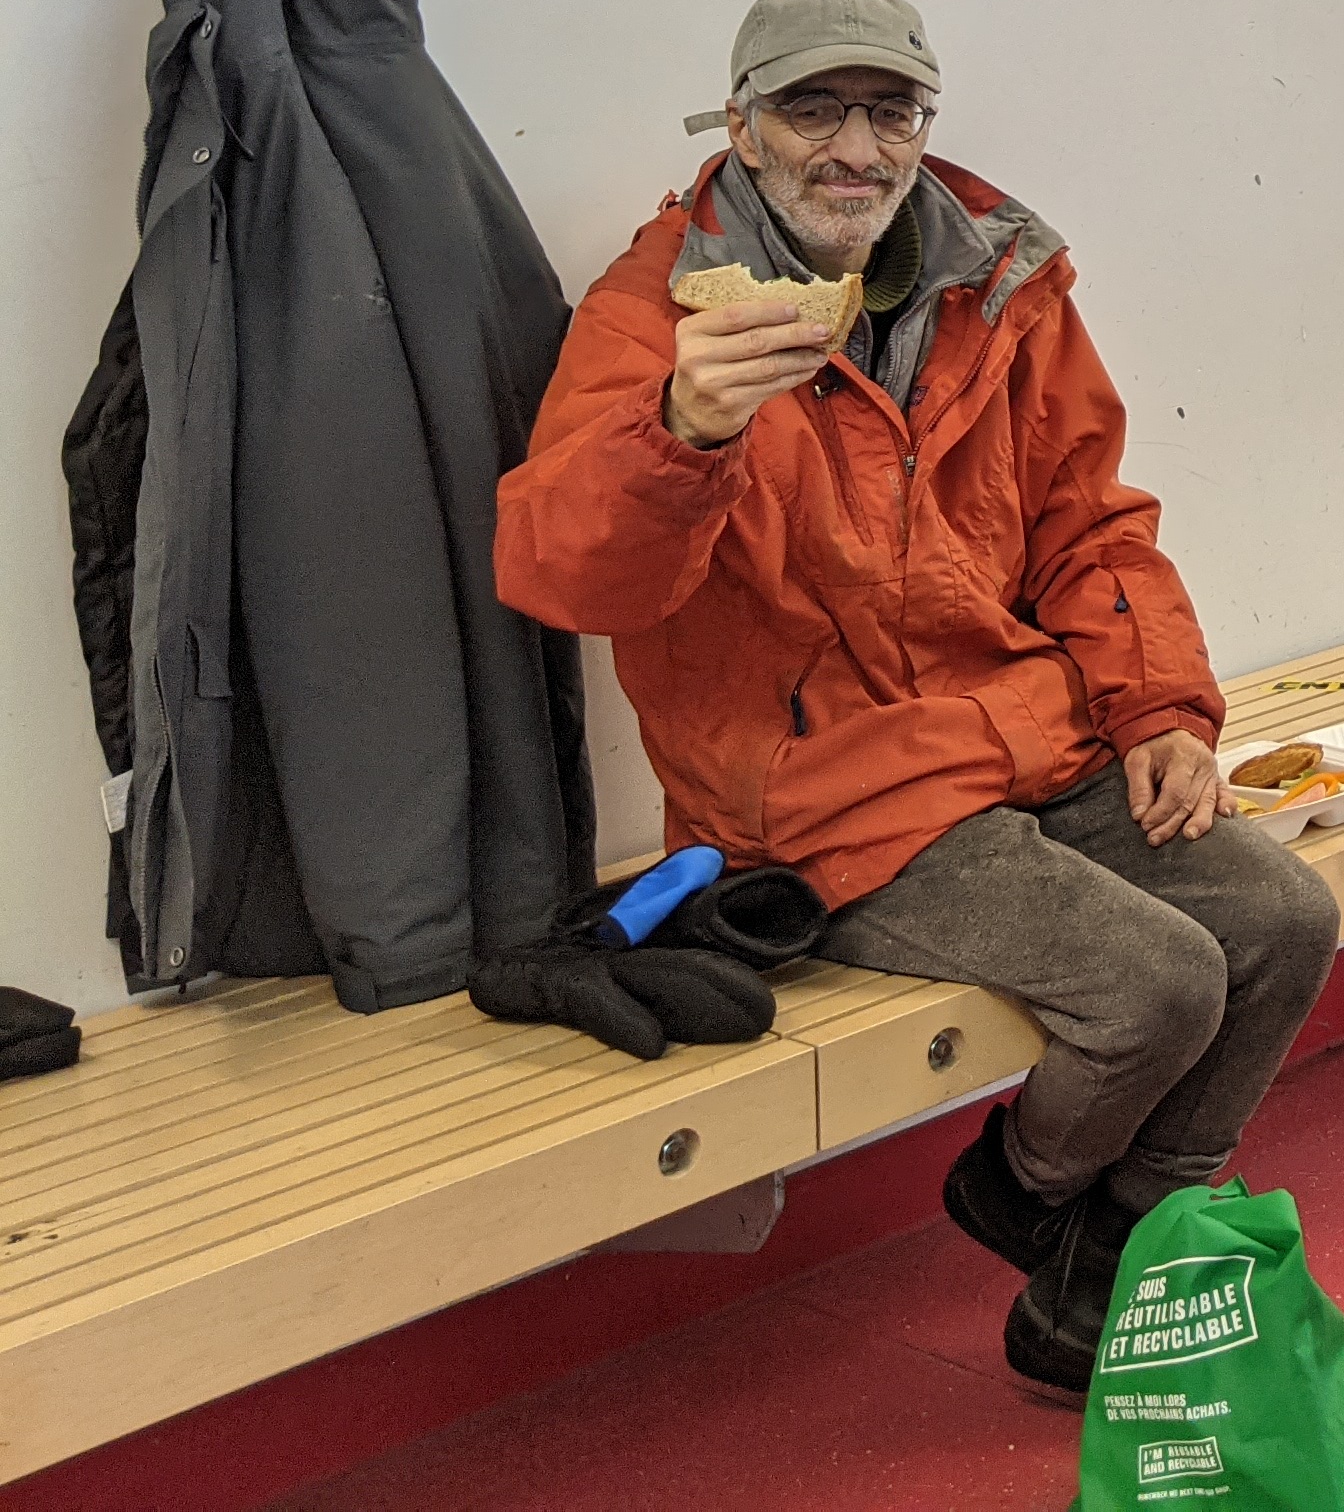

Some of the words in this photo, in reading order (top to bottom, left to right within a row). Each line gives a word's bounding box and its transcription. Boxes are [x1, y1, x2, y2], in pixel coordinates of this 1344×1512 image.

[1136, 1275, 1168, 1302] SUIS
[1108, 1335, 1129, 1361] ET
[1131, 1309, 1244, 1356] RECYCLABLE
[1103, 1394, 1136, 1408] PENSEZ
[1136, 1391, 1144, 1407] À
[1144, 1393, 1163, 1407] MOI
[1163, 1393, 1187, 1407] LORS
[1106, 1408, 1119, 1421] DE
[1119, 1408, 1137, 1420] VOS
[1137, 1408, 1185, 1421] PROCHAINS
[1185, 1401, 1232, 1421] ACHATS.
[1143, 1447, 1163, 1462] I'M
[1143, 1460, 1165, 1476] AND
